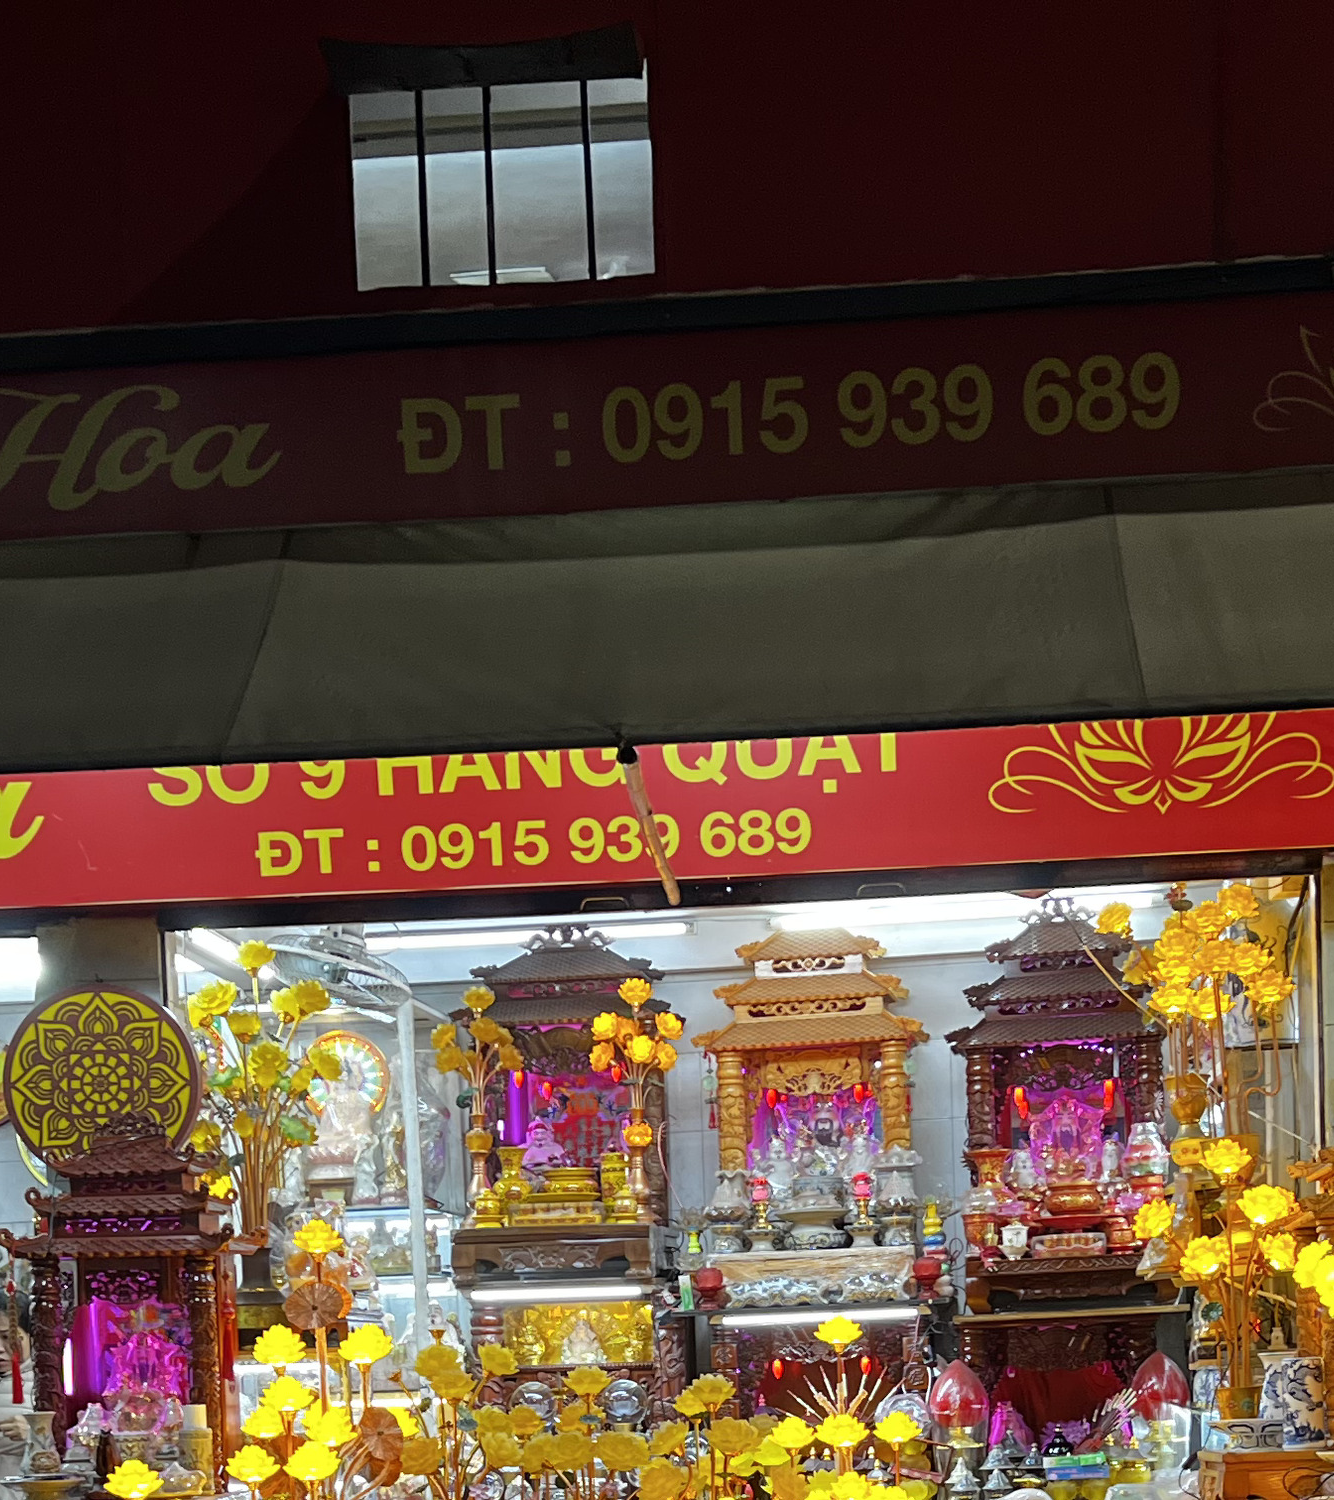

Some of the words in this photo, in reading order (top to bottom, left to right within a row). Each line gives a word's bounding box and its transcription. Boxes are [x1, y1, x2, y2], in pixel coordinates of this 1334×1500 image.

[396, 392, 521, 475] ĐT
[601, 374, 810, 466] 0915
[835, 362, 995, 451] 939
[1022, 350, 1183, 437] 689
[255, 827, 344, 878] ĐT
[400, 819, 550, 873] 0915
[568, 812, 680, 864] 939
[699, 807, 812, 858] 689
